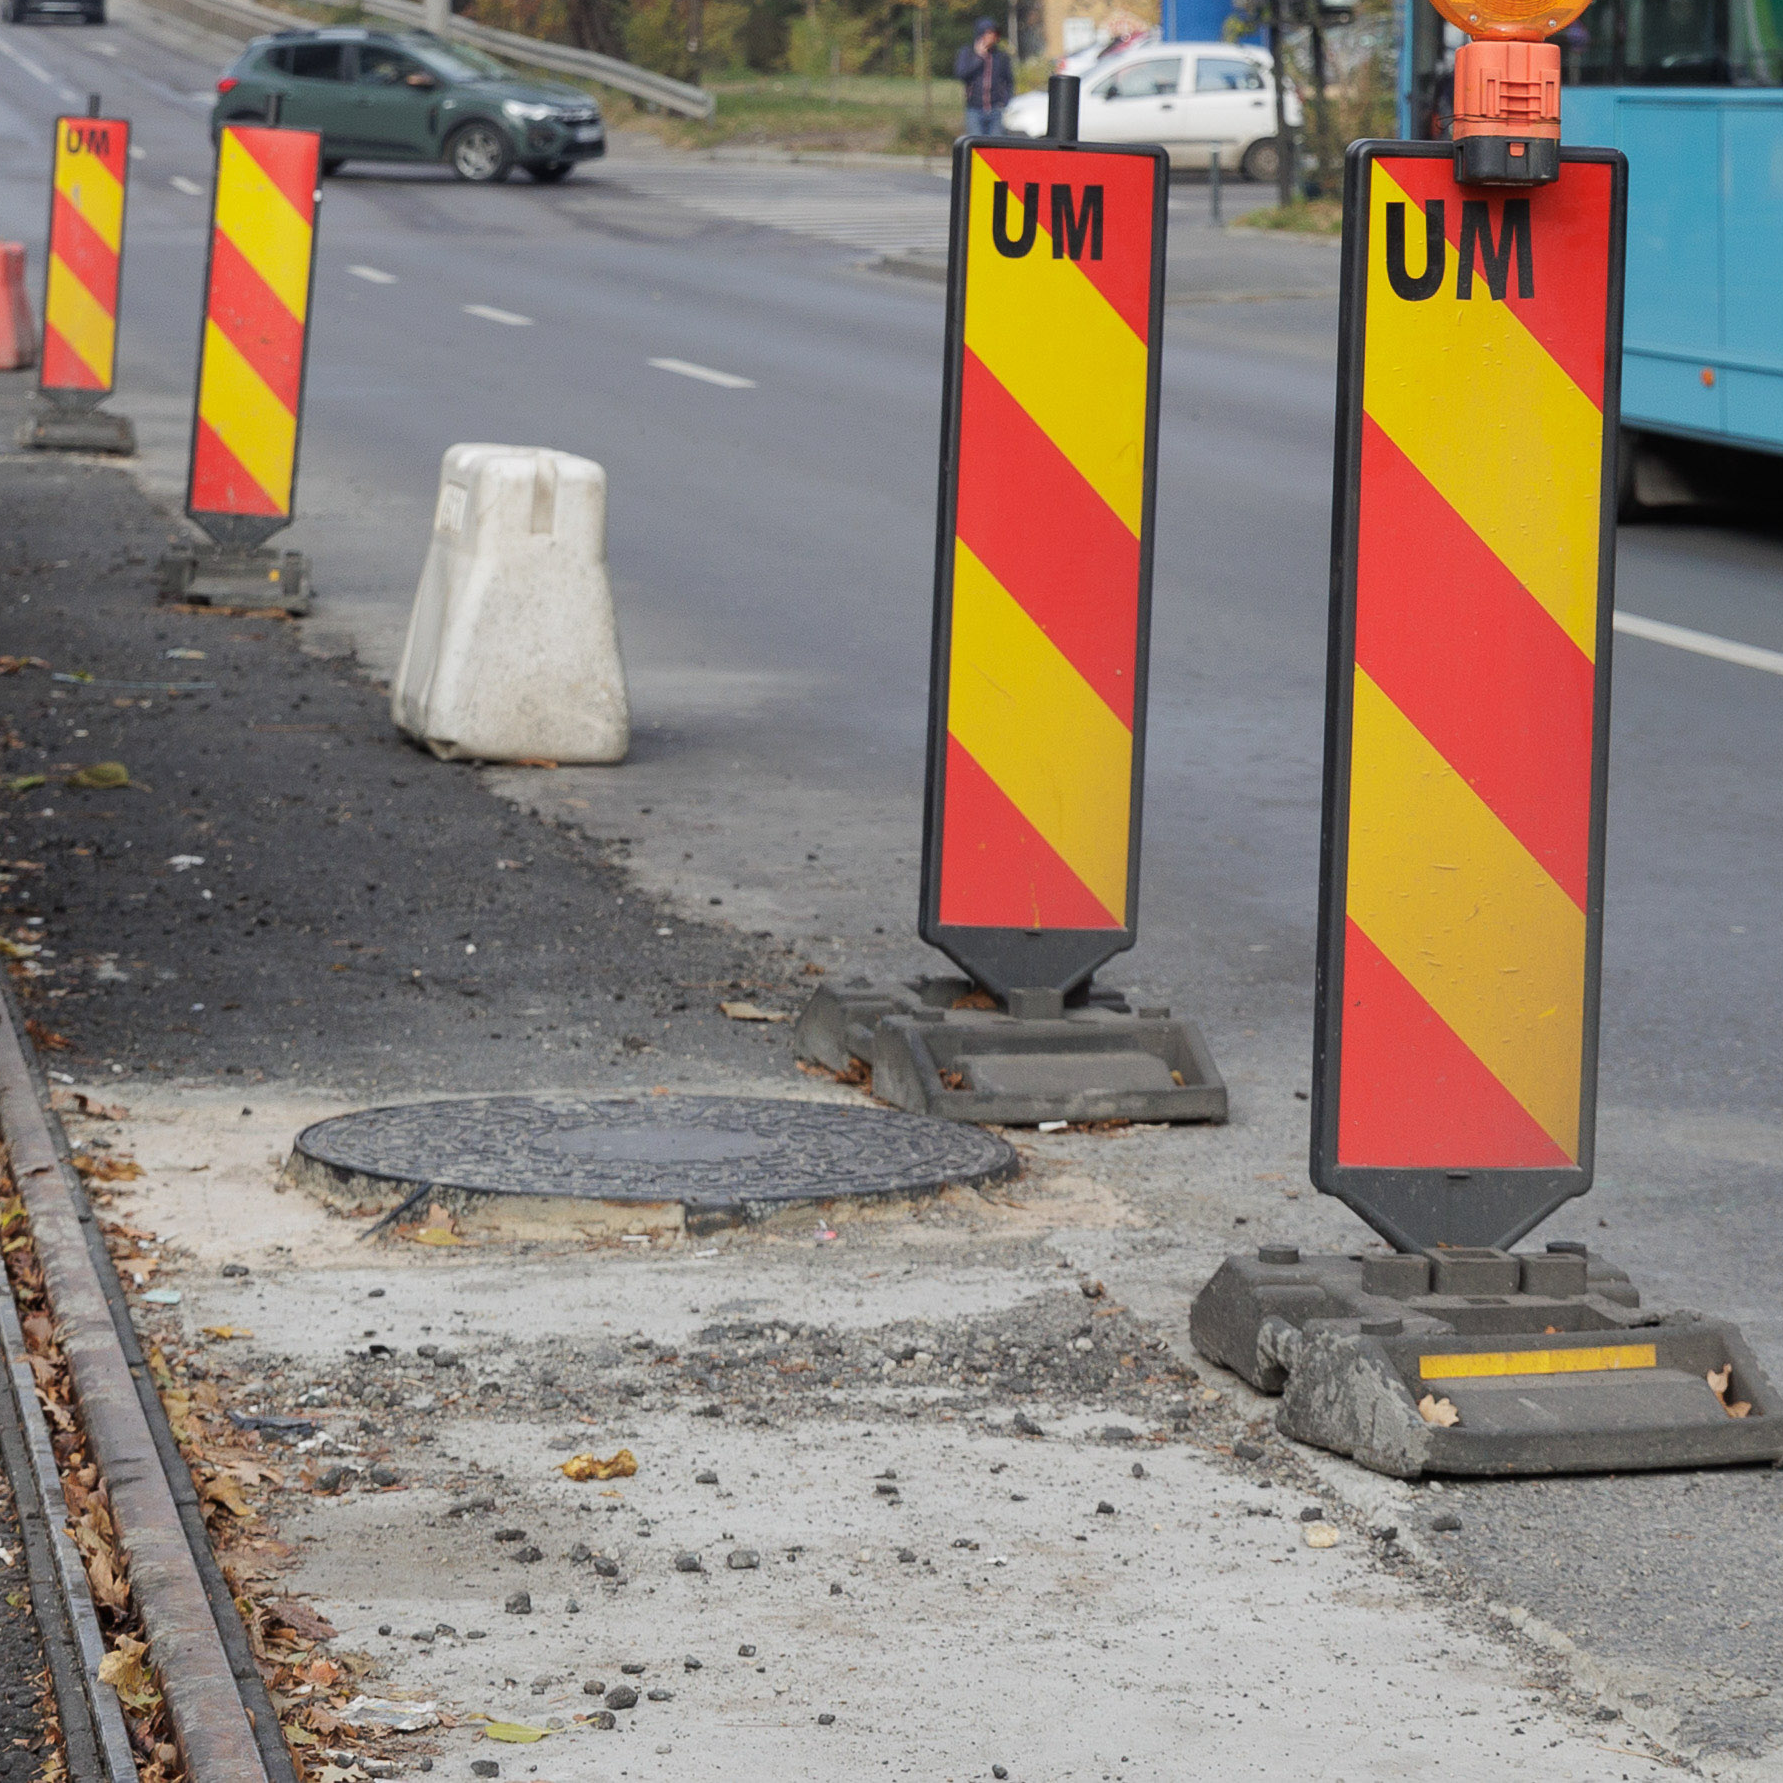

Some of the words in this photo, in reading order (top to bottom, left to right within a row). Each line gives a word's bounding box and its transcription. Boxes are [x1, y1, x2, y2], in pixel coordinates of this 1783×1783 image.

[67, 127, 110, 155] UM
[992, 180, 1104, 261] UM
[1385, 199, 1535, 302] UM
